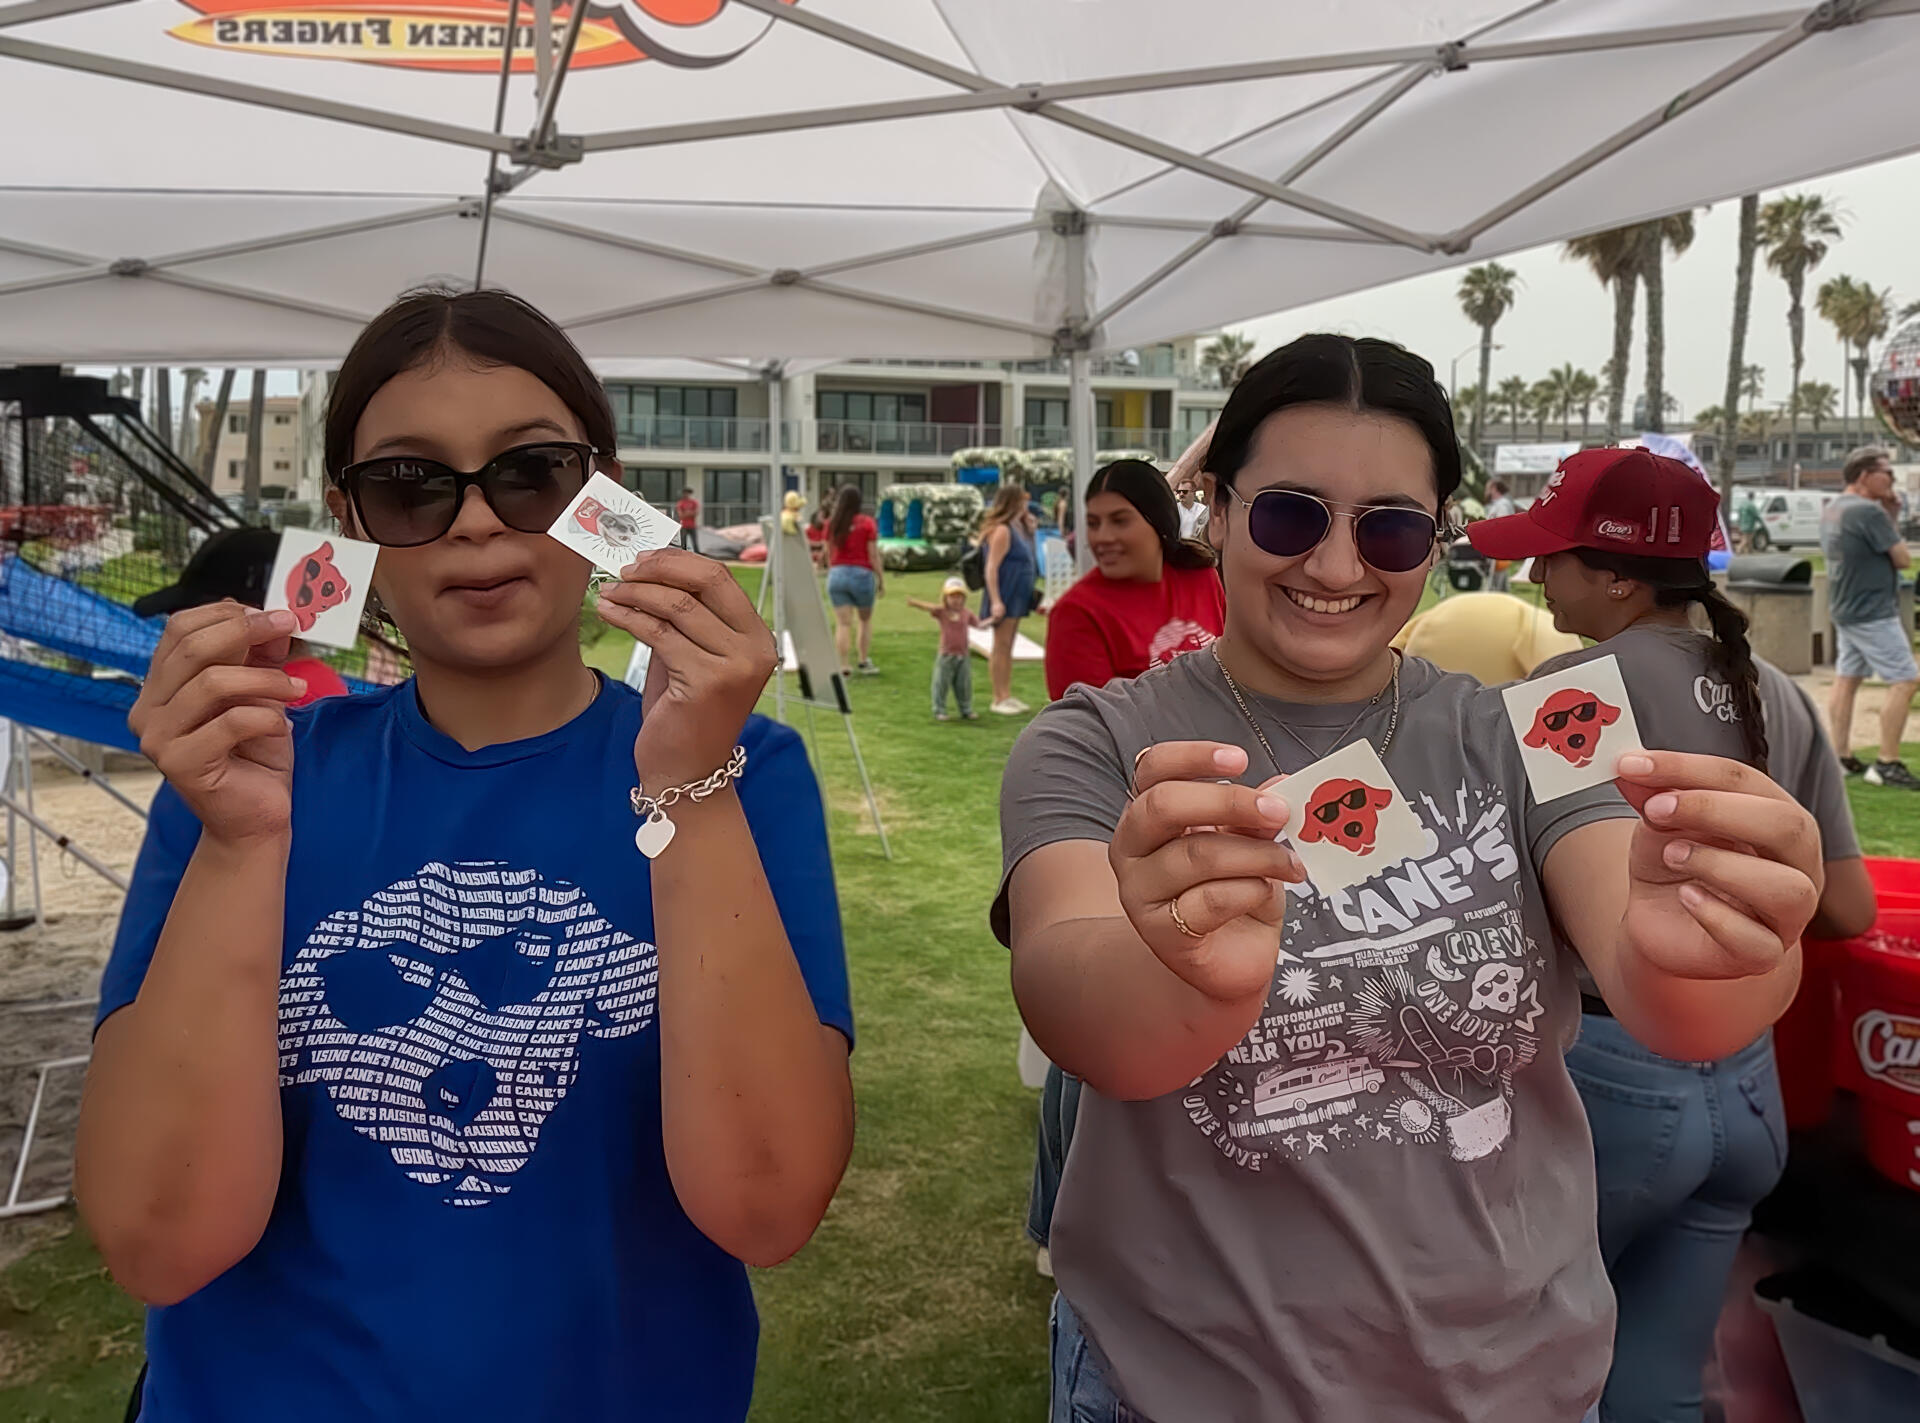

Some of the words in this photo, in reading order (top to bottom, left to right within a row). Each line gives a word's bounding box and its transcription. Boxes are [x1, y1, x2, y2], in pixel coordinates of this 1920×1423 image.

[452, 870, 500, 885] RAISING
[1329, 826, 1519, 934] CANE'S
[457, 889, 504, 904] RAISING
[461, 907, 505, 922] RAISING
[1445, 923, 1527, 965] CREW
[1263, 1002, 1346, 1029] PERFORMANCES
[1266, 1028, 1279, 1040] AT
[1283, 1026, 1291, 1036] A
[1293, 1013, 1344, 1034] LOCATION
[306, 1033, 359, 1046] RAISING
[358, 1035, 398, 1052] CANE'S
[1226, 1041, 1281, 1065] NEAR
[1283, 1030, 1327, 1053] YOU
[351, 1050, 391, 1067] CANE'S
[344, 1068, 384, 1085] CANE'S
[339, 1085, 379, 1102] CANE'S
[379, 1107, 427, 1124] RAISING
[1183, 1095, 1222, 1136] ONE
[463, 1125, 520, 1137] RAISING
[379, 1127, 430, 1143] RAISING
[469, 1141, 528, 1154] RAISING
